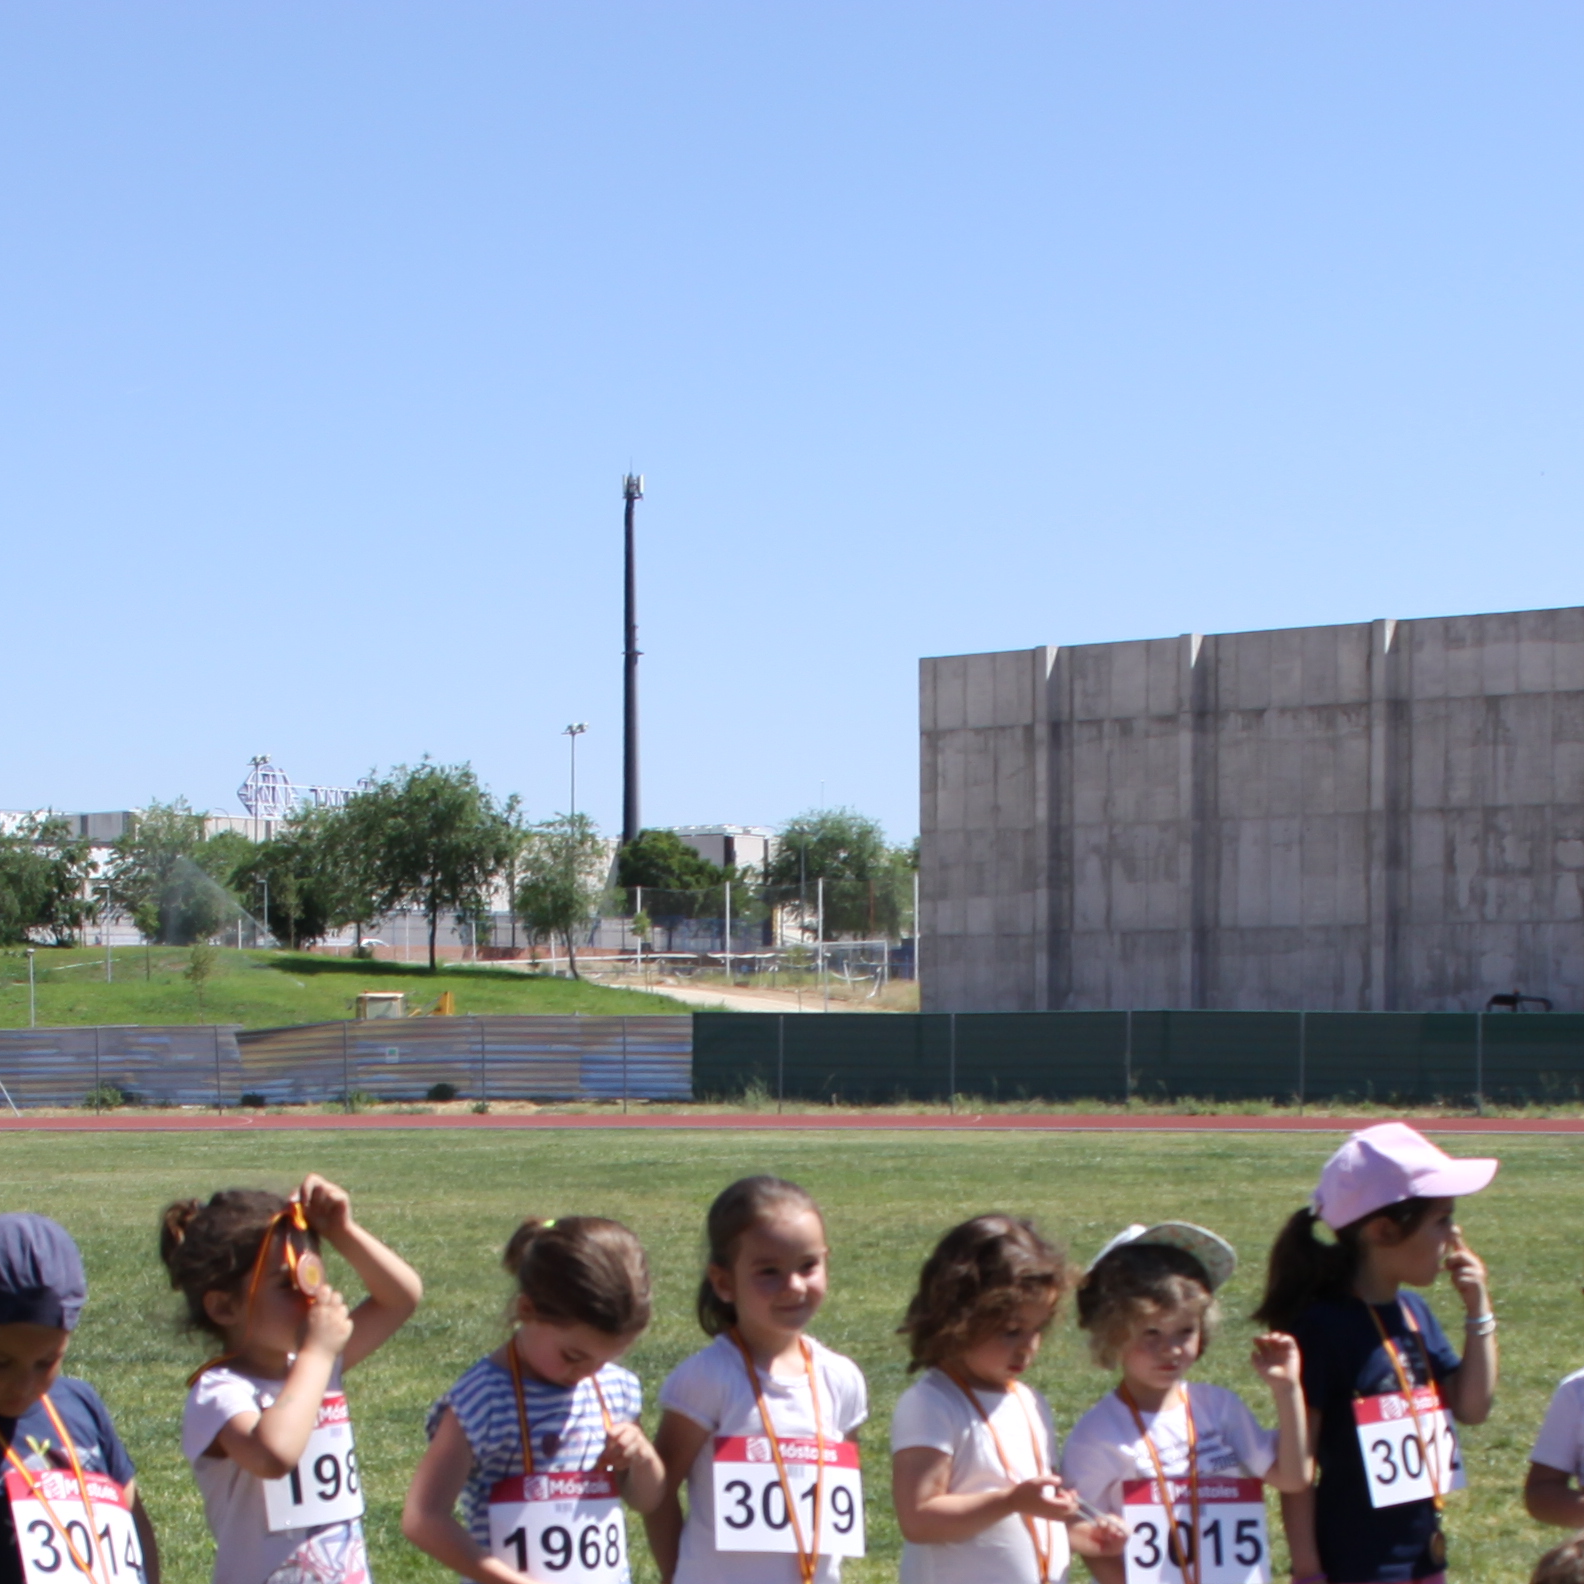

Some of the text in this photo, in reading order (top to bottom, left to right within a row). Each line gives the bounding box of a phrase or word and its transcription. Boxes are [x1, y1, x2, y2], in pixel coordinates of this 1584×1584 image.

[724, 1479, 854, 1534] 3019
[1174, 1484, 1240, 1499] Mstoles
[27, 1518, 143, 1580] 3014
[503, 1523, 620, 1573] 1968
[1133, 1518, 1263, 1569] 3015
